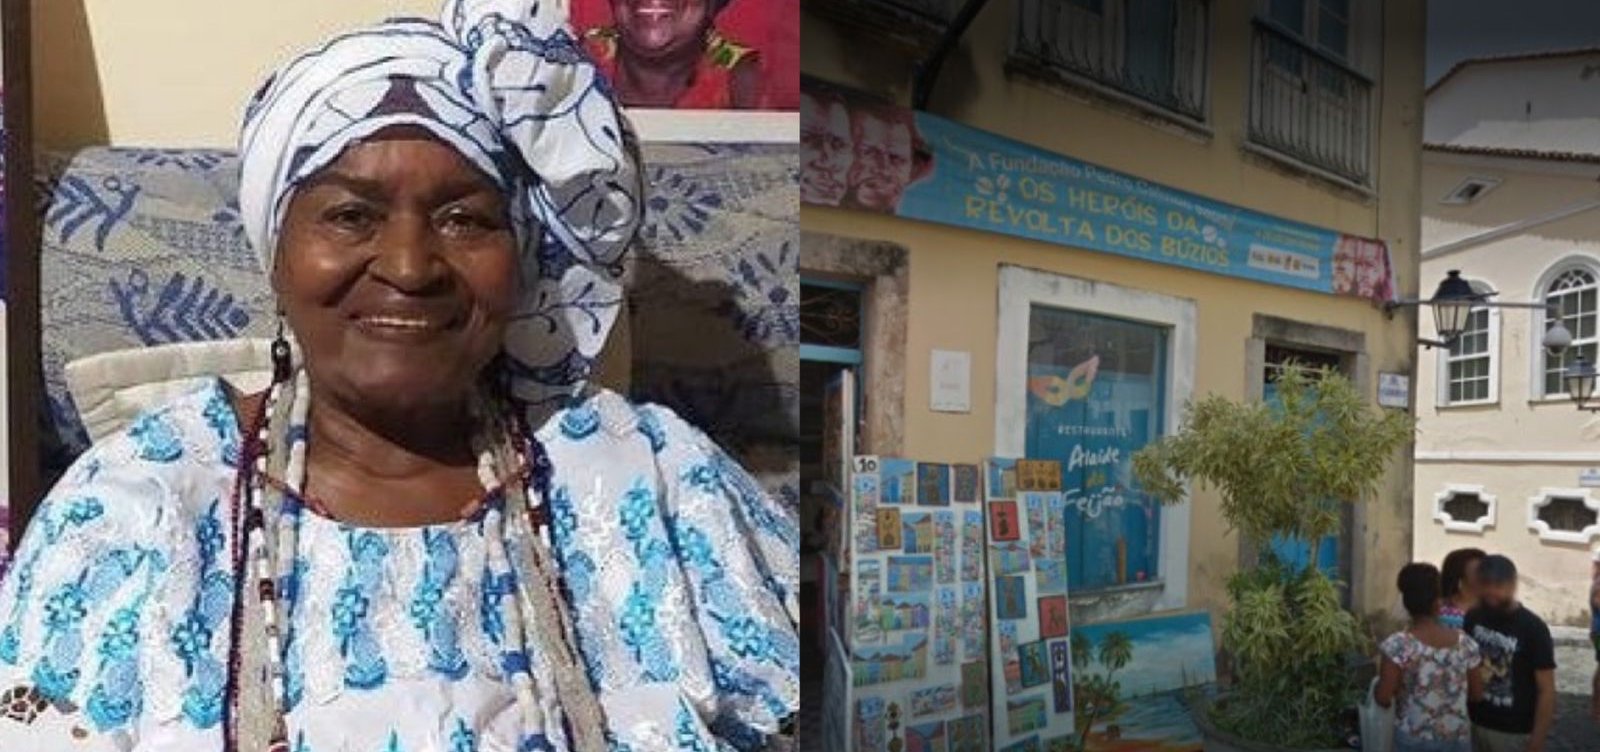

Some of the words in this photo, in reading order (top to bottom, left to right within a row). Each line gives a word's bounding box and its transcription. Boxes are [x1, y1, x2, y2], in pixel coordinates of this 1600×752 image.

[965, 195, 1095, 242] REVOLTA
[1105, 224, 1152, 251] DOS
[1161, 235, 1230, 267] BÚZIOS
[1019, 177, 1056, 204] OS
[1067, 186, 1158, 227] HERÓIS
[1167, 210, 1199, 235] DA
